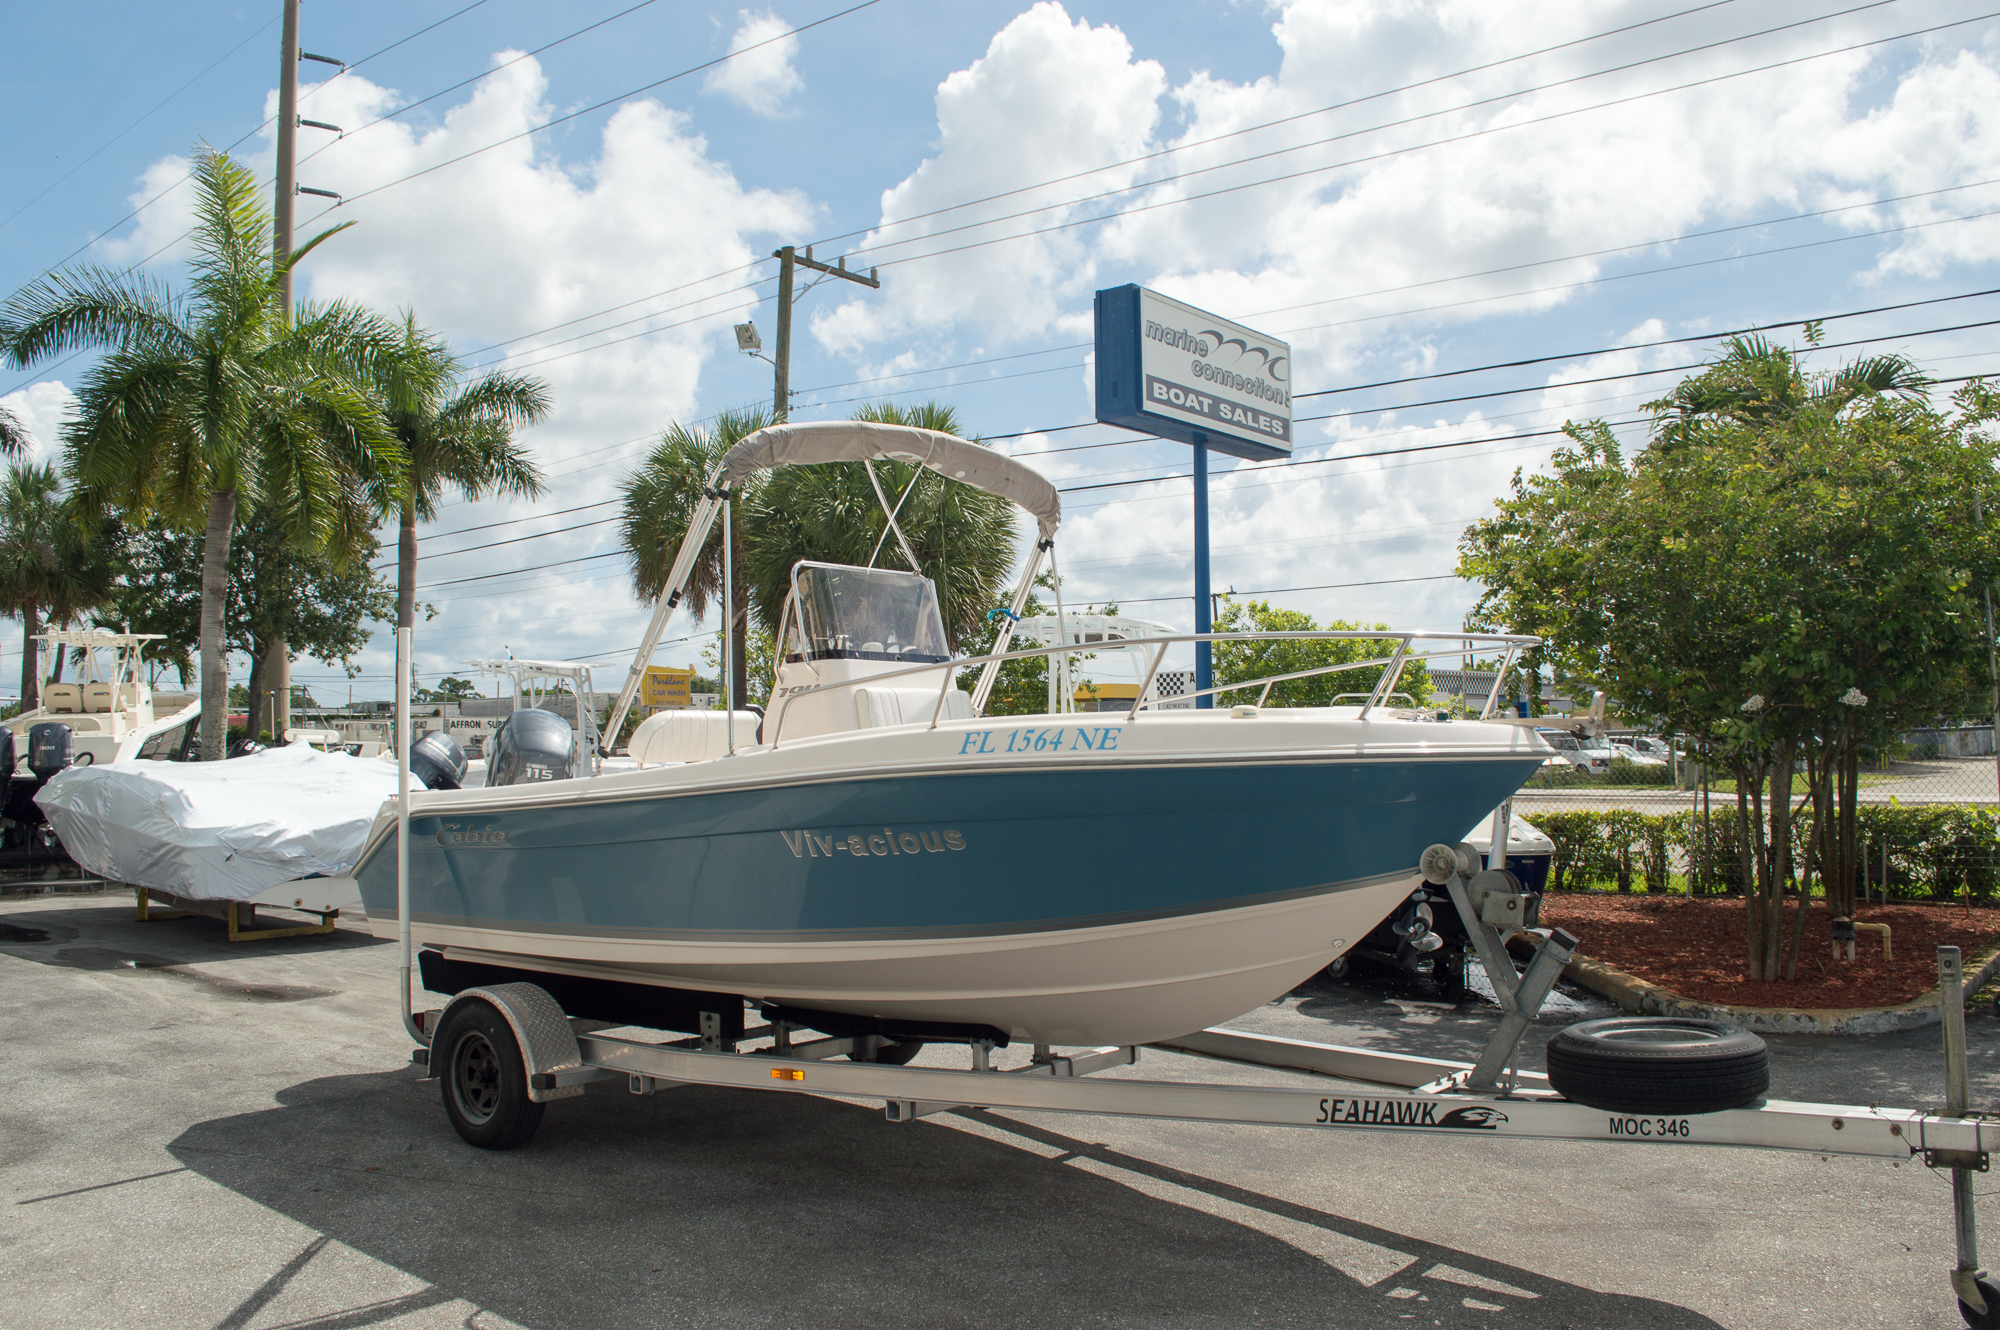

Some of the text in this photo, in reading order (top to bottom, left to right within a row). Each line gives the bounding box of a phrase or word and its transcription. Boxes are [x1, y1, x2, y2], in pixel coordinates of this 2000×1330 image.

[1145, 320, 1208, 358] marine
[1153, 382, 1283, 435] BOAT SALES
[652, 674, 685, 685] Parklane
[451, 720, 481, 729] AFFRON
[957, 728, 1122, 755] FL 1564 NE
[525, 768, 553, 780] 115
[435, 823, 510, 847] Cobia
[780, 827, 966, 858] Viv-acious
[1316, 1098, 1438, 1125] SEAHAWK
[1609, 1117, 1690, 1137] MOC 346
